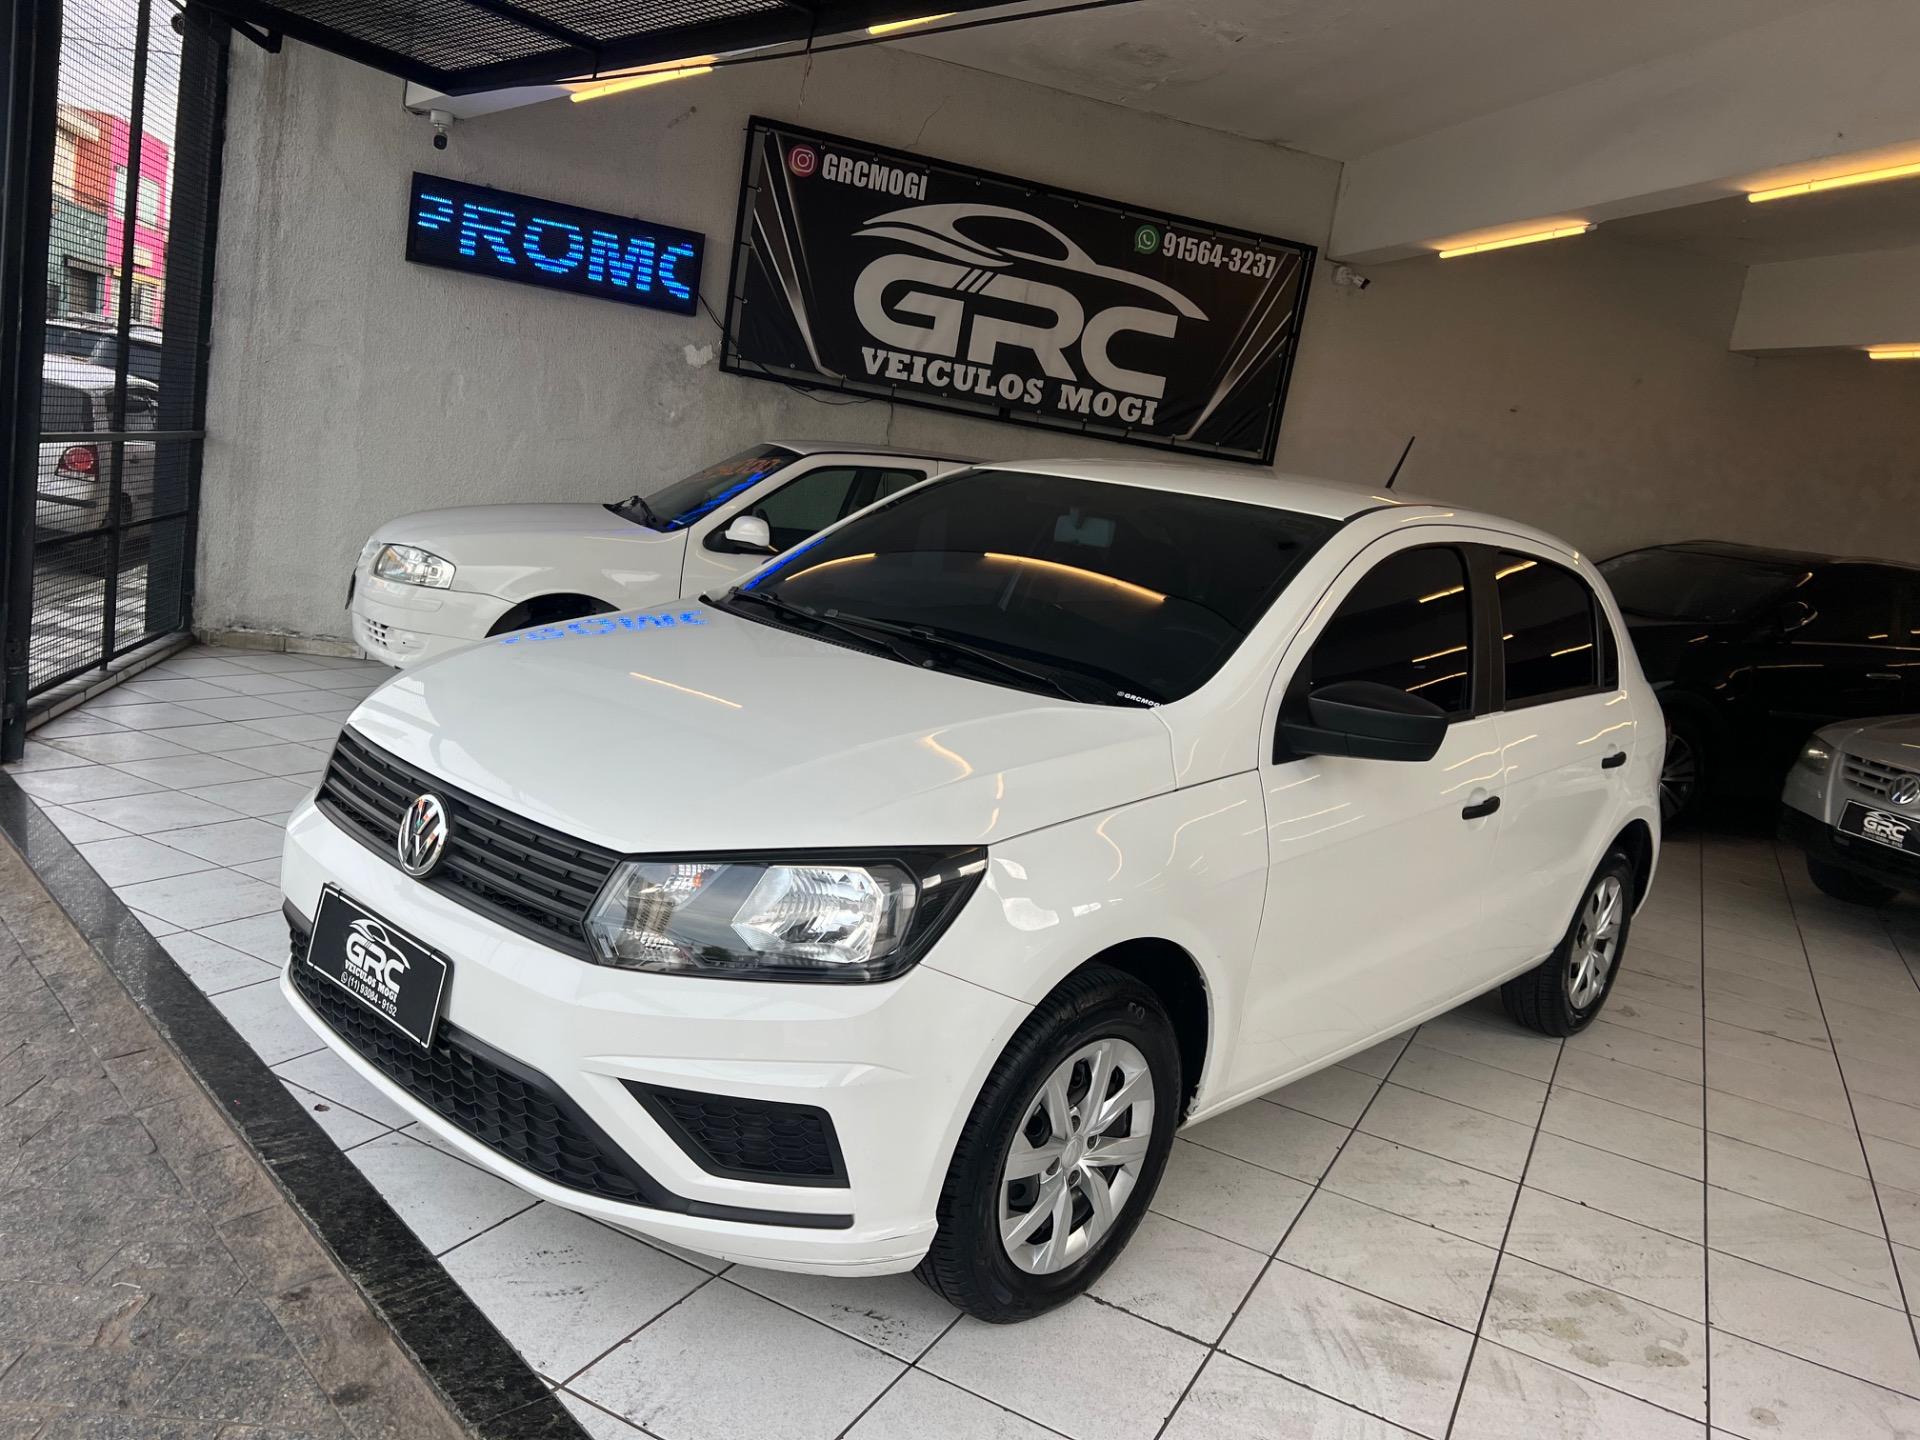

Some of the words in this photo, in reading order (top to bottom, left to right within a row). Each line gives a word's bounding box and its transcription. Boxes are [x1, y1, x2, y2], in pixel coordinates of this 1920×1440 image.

[822, 153, 928, 200] GRCMOGI
[1162, 232, 1277, 279] 91564-3237
[853, 253, 1179, 400] GRC
[861, 346, 1045, 405] VEICULOS
[1057, 383, 1159, 426] MOGI
[1863, 815, 1908, 840] GRC
[345, 959, 377, 988] VEICULOS
[377, 982, 398, 1003] MOGI
[346, 932, 405, 994] GRC
[347, 975, 360, 993] (11)
